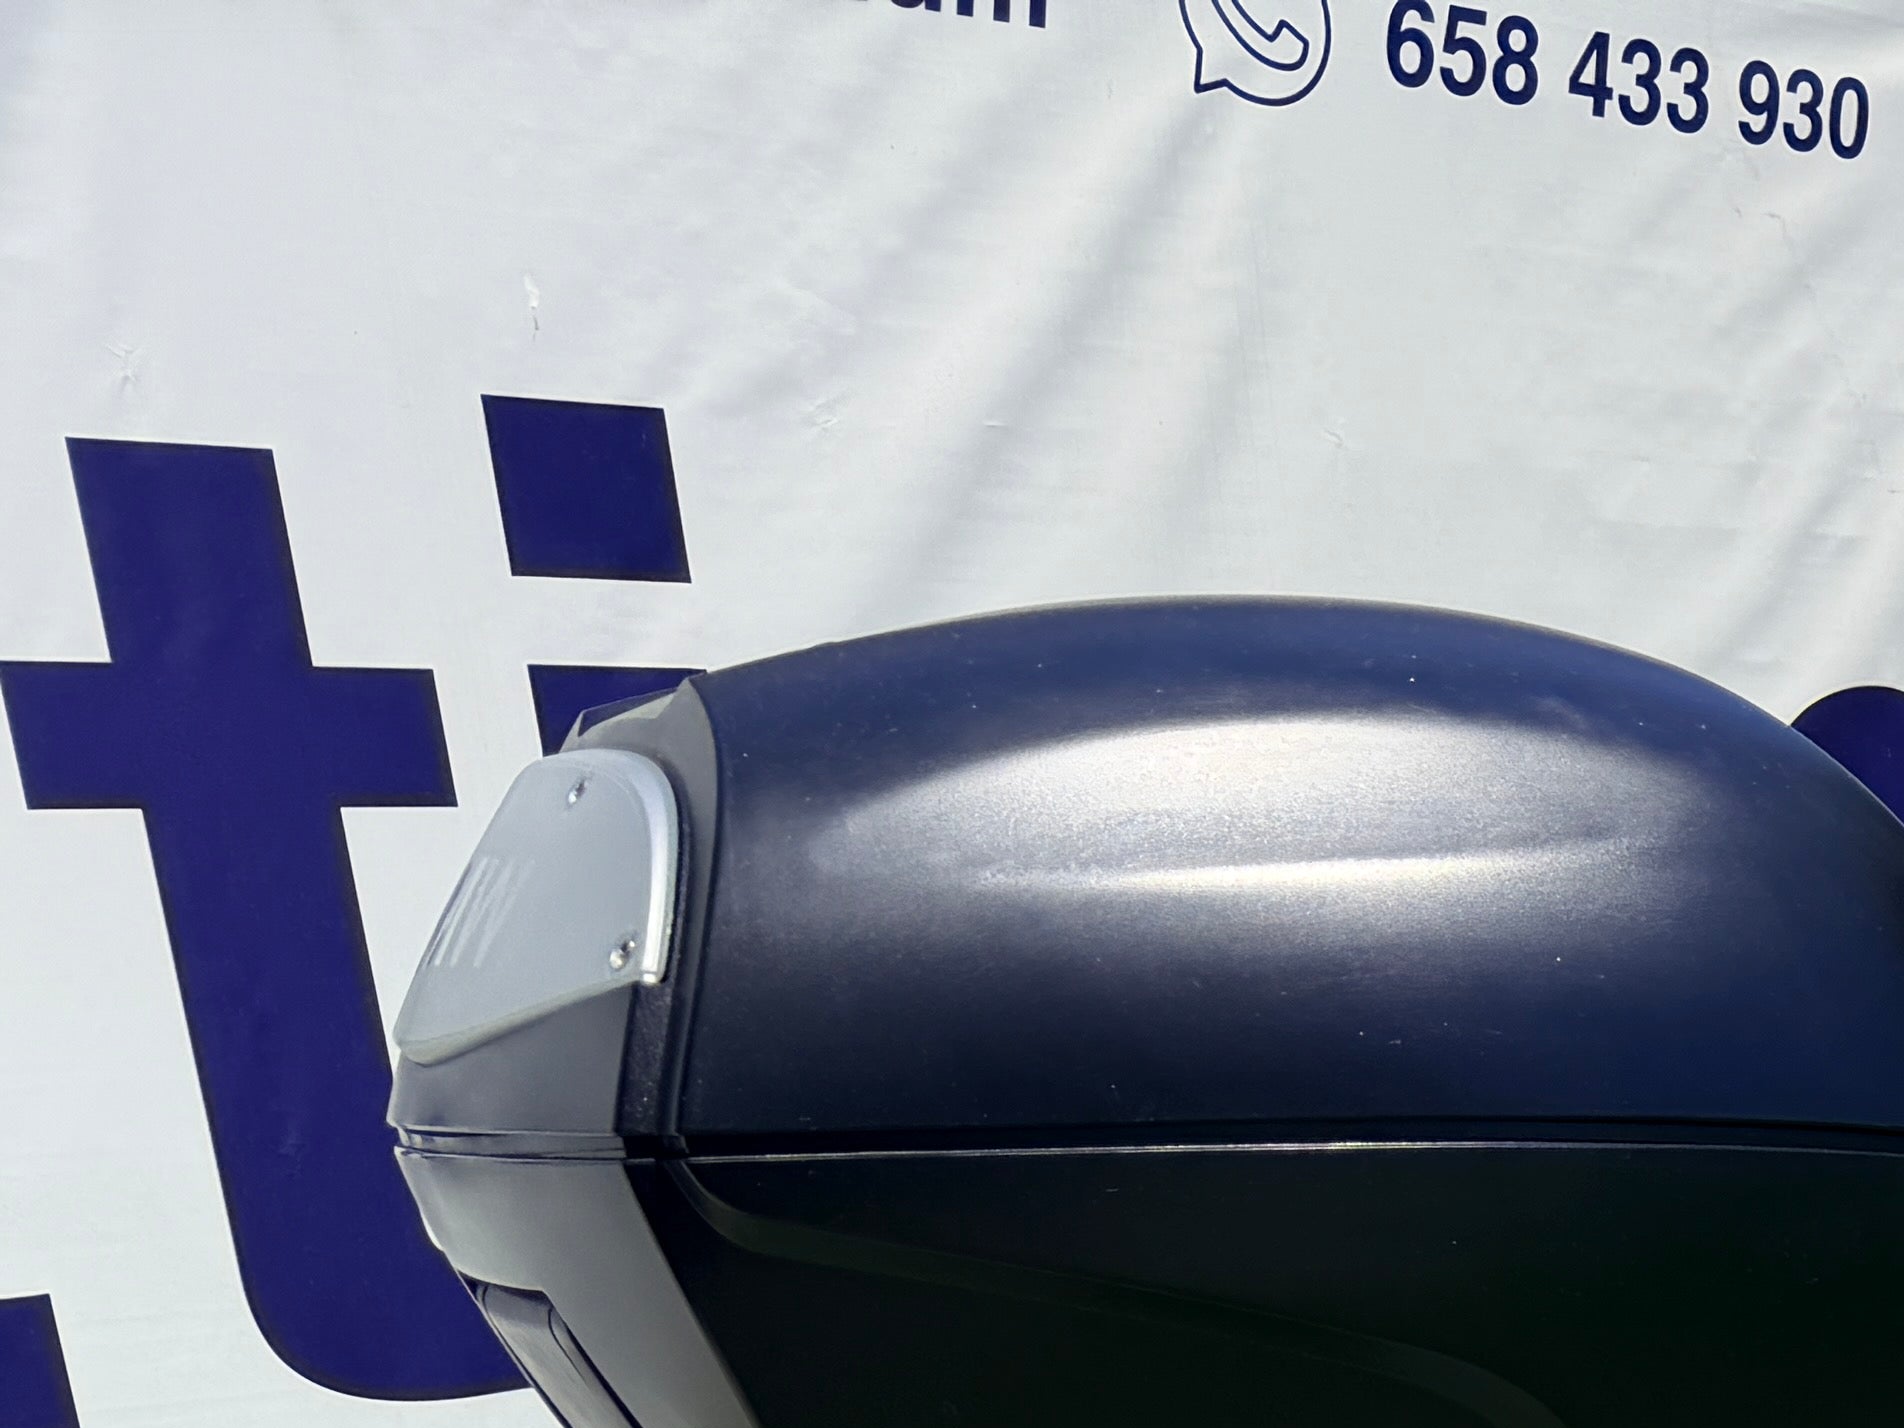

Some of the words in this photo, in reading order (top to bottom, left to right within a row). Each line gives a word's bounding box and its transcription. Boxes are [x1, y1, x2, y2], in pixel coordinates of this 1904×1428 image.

[1386, 0, 1539, 105] 658
[1568, 31, 1710, 134] 433
[1738, 60, 1869, 160] 930
